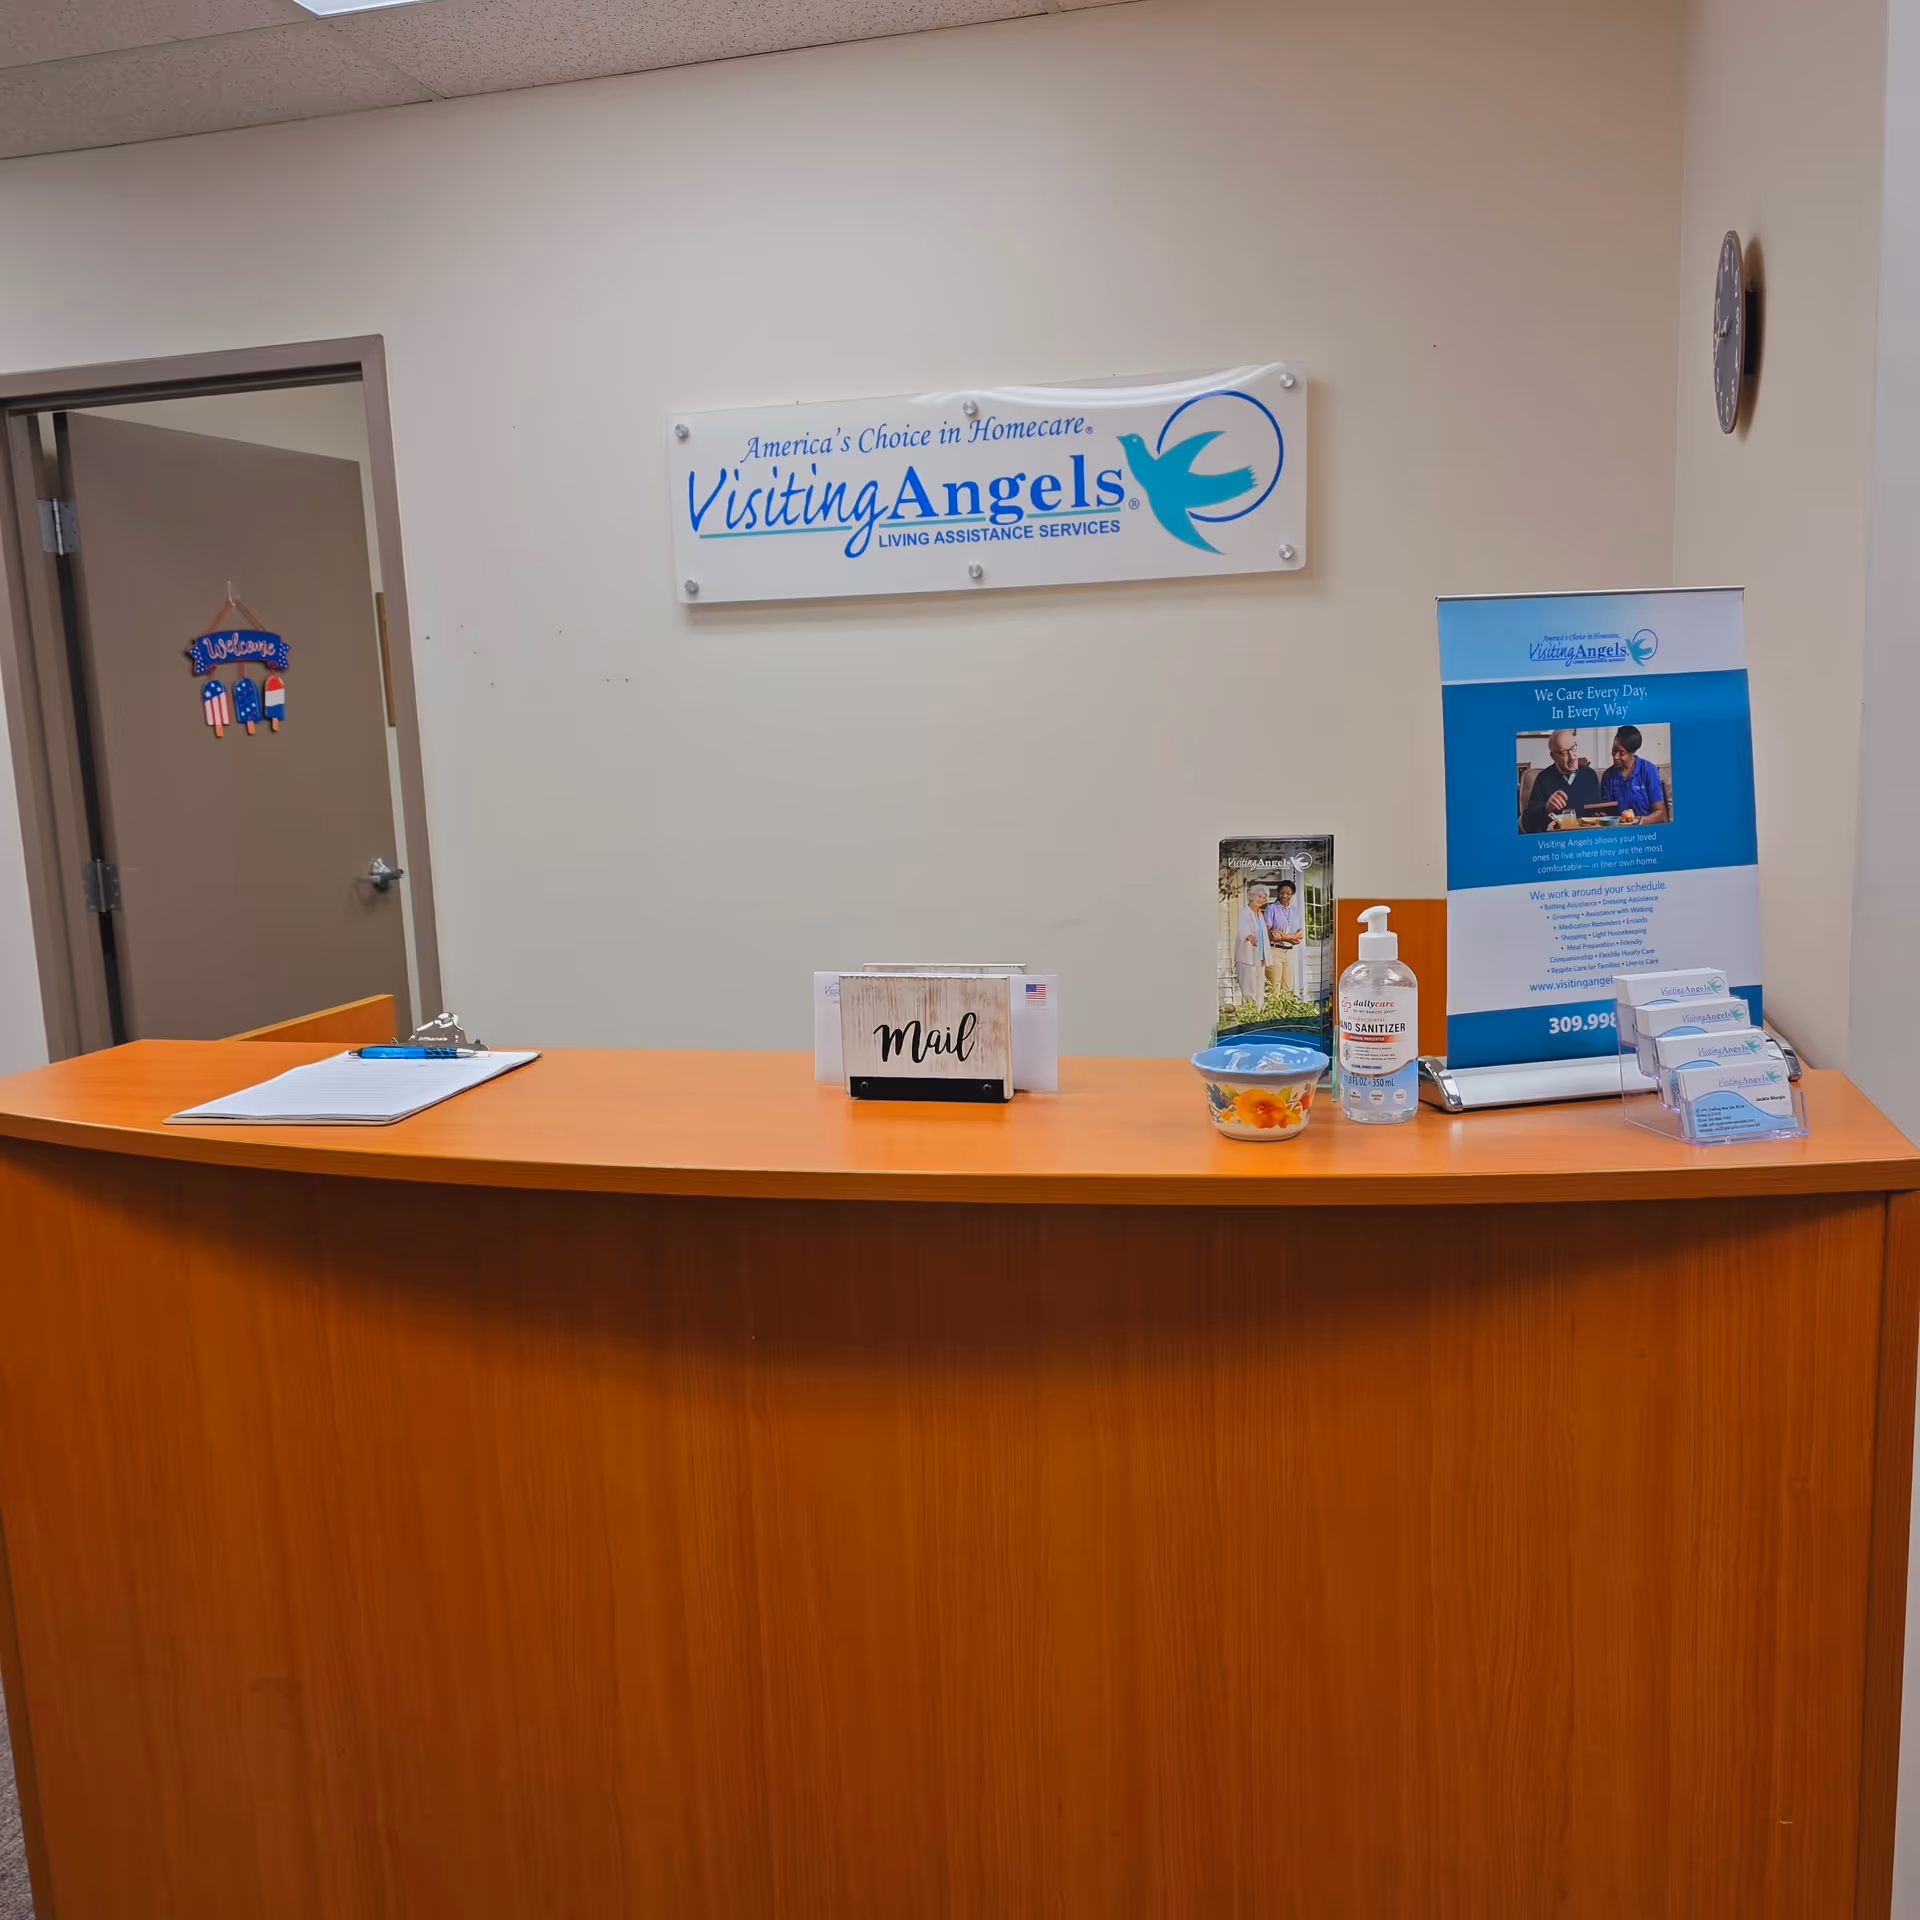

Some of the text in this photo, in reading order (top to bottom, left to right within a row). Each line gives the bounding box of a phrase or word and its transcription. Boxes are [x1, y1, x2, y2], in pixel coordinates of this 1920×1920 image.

[740, 427, 851, 463] America's
[858, 423, 931, 454] Choice
[940, 421, 961, 444] in
[879, 520, 1121, 548] LIVING ASSISTANCE SERVICES
[202, 632, 276, 660] Welcome
[1534, 684, 1648, 702] We Care Every Day,
[1552, 702, 1629, 720] In Every Way
[1537, 832, 1657, 849] Visiting Angels allows your loved
[1532, 844, 1663, 862] ones to live where they are the most
[1591, 861, 1599, 869] in
[1600, 859, 1617, 869] their
[1618, 859, 1635, 867] own
[1636, 856, 1659, 866] home.
[1529, 880, 1668, 901] We work around your schedule.
[1544, 894, 1659, 911] Bathing Assistance Dressing Assistance
[1552, 905, 1654, 921] Grooming Assistance with Walking
[1558, 915, 1649, 931] Medication Reminders Errands
[1560, 927, 1648, 942] Shopping Light Housekeeping
[1566, 938, 1643, 951] Meal Preparation Friendly
[1549, 947, 1656, 964] Companionship Flexible Hourly Care
[1551, 966, 1573, 974] Respite
[1573, 964, 1588, 972] Care
[1587, 963, 1597, 971] for
[1597, 961, 1621, 970] Families
[1645, 958, 1660, 966] Care
[1340, 1020, 1406, 1033] AND SANITIZER
[873, 1012, 976, 1063] Mail
[1360, 1077, 1367, 1087] OZ
[1372, 1078, 1385, 1087] 350
